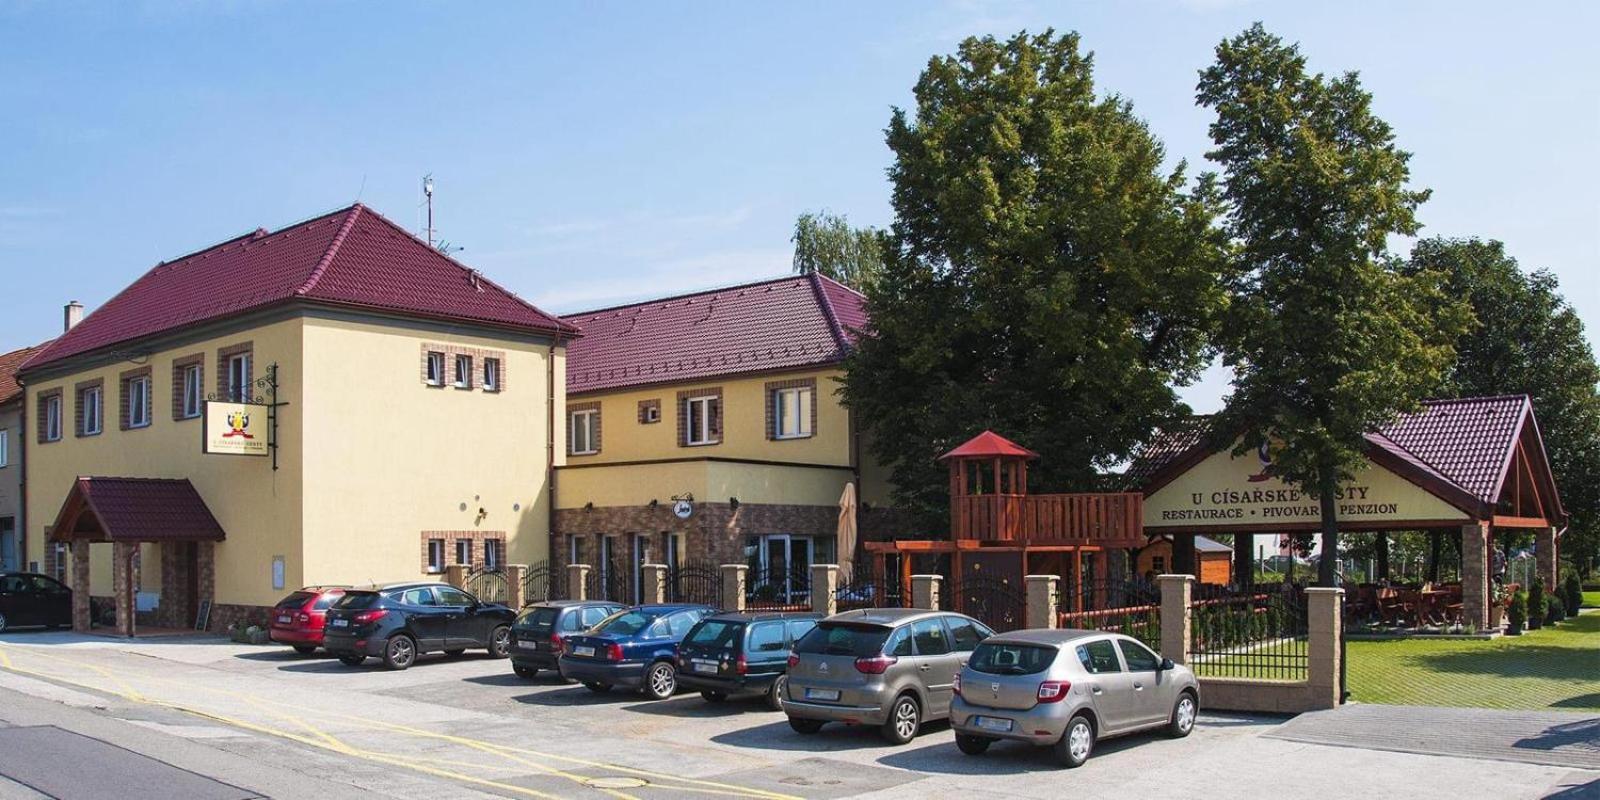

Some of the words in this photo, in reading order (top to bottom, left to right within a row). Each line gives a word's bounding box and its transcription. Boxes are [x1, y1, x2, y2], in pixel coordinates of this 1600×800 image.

[1191, 492, 1203, 505] U
[1211, 484, 1301, 504] CÍSAŘSKÉ
[1162, 508, 1244, 520] RESTAURACE
[1263, 505, 1320, 517] PIVOVAR
[1339, 503, 1398, 516] PENZION
